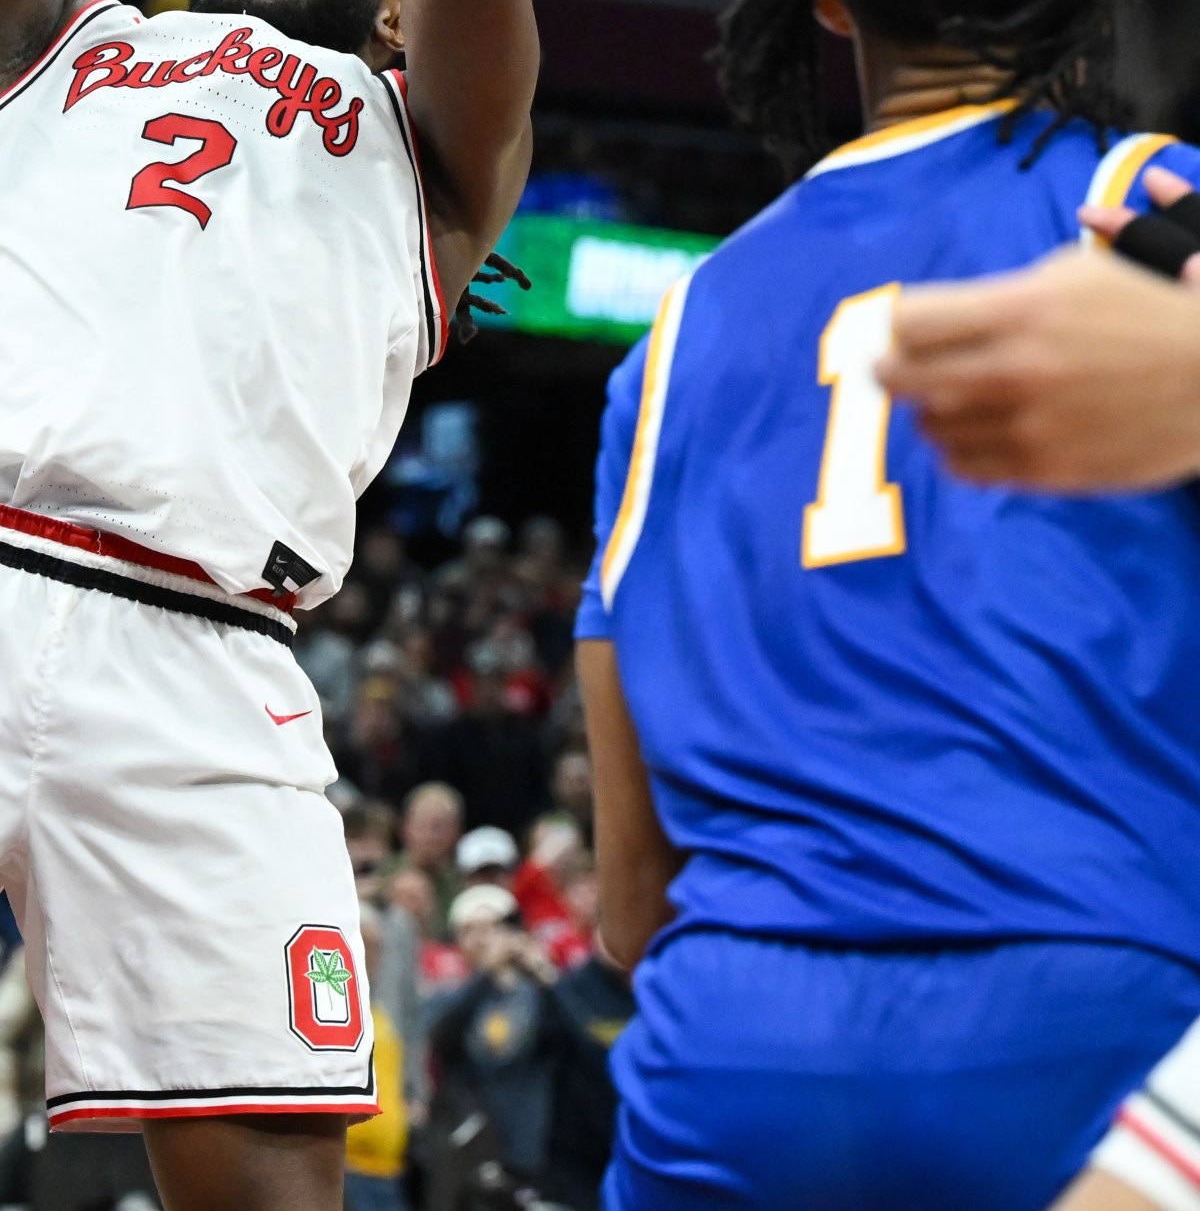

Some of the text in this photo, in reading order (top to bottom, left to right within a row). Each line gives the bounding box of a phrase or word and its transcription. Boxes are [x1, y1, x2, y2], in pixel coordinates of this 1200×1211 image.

[62, 27, 364, 157] Buckeyes
[125, 112, 238, 231] 2
[801, 280, 906, 570] 1
